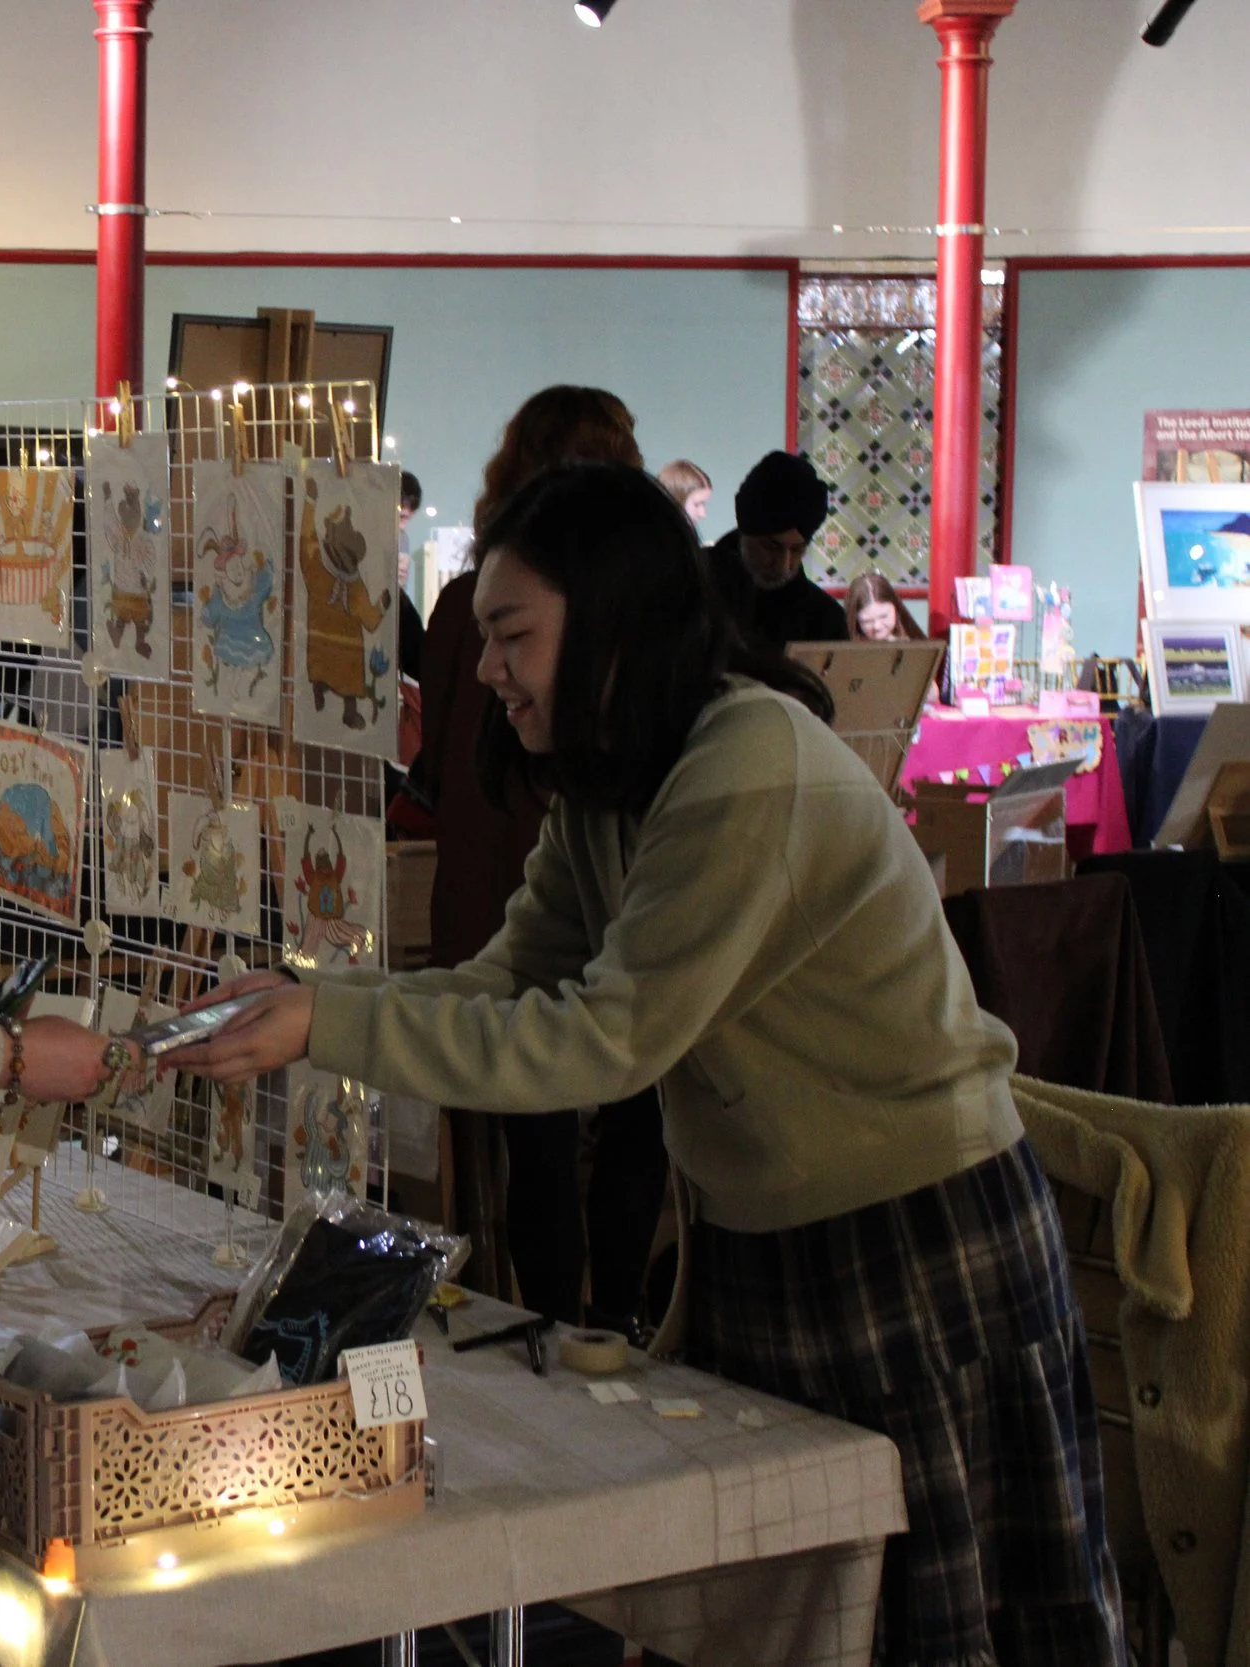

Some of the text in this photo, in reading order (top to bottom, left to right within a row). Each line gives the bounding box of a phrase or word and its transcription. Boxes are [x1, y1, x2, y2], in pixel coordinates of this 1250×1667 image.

[1157, 416, 1250, 429] The Leeds Institut
[1156, 429, 1250, 441] and the Albert Ha
[370, 1379, 414, 1420] £18
